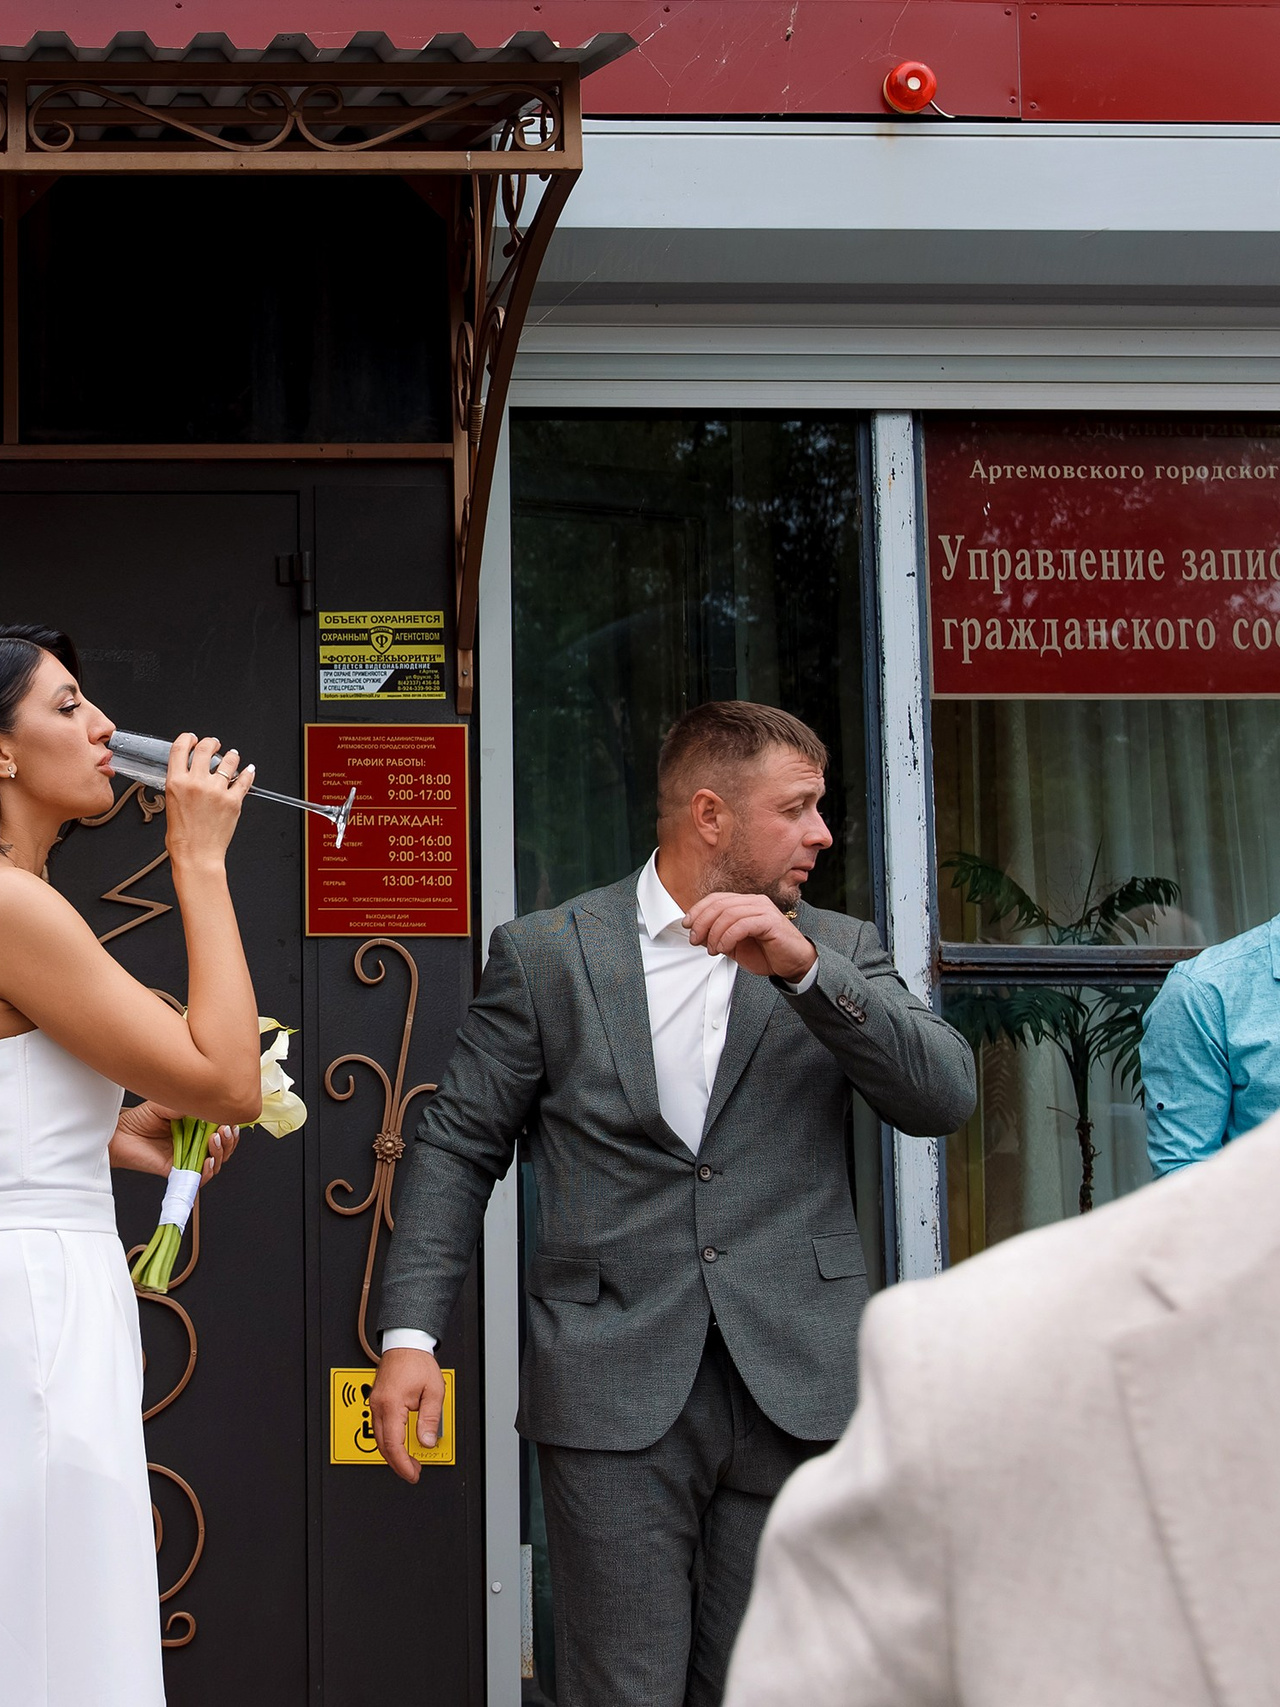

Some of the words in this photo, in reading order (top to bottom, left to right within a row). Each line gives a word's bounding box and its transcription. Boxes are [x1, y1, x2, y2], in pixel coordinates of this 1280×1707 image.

[970, 459, 1144, 485] Артемовского
[1155, 464, 1279, 485] городског
[938, 535, 1166, 594] Управление
[324, 615, 367, 624] ОБЪЕКТ
[371, 615, 440, 624] ОХРАНЯЕТСЯ
[941, 617, 1216, 664] гражданского
[348, 758, 384, 767] ГРАФИК
[386, 758, 426, 767] РАБОТЫ:
[387, 774, 451, 785] 9:00-18:00
[387, 789, 451, 801] 9:00-17:00
[378, 815, 443, 827] ГРАЖДАН:
[388, 835, 451, 847] 9:00-16:00
[388, 851, 451, 862] 9:00-13:00
[382, 875, 452, 887] 13:00-14:00
